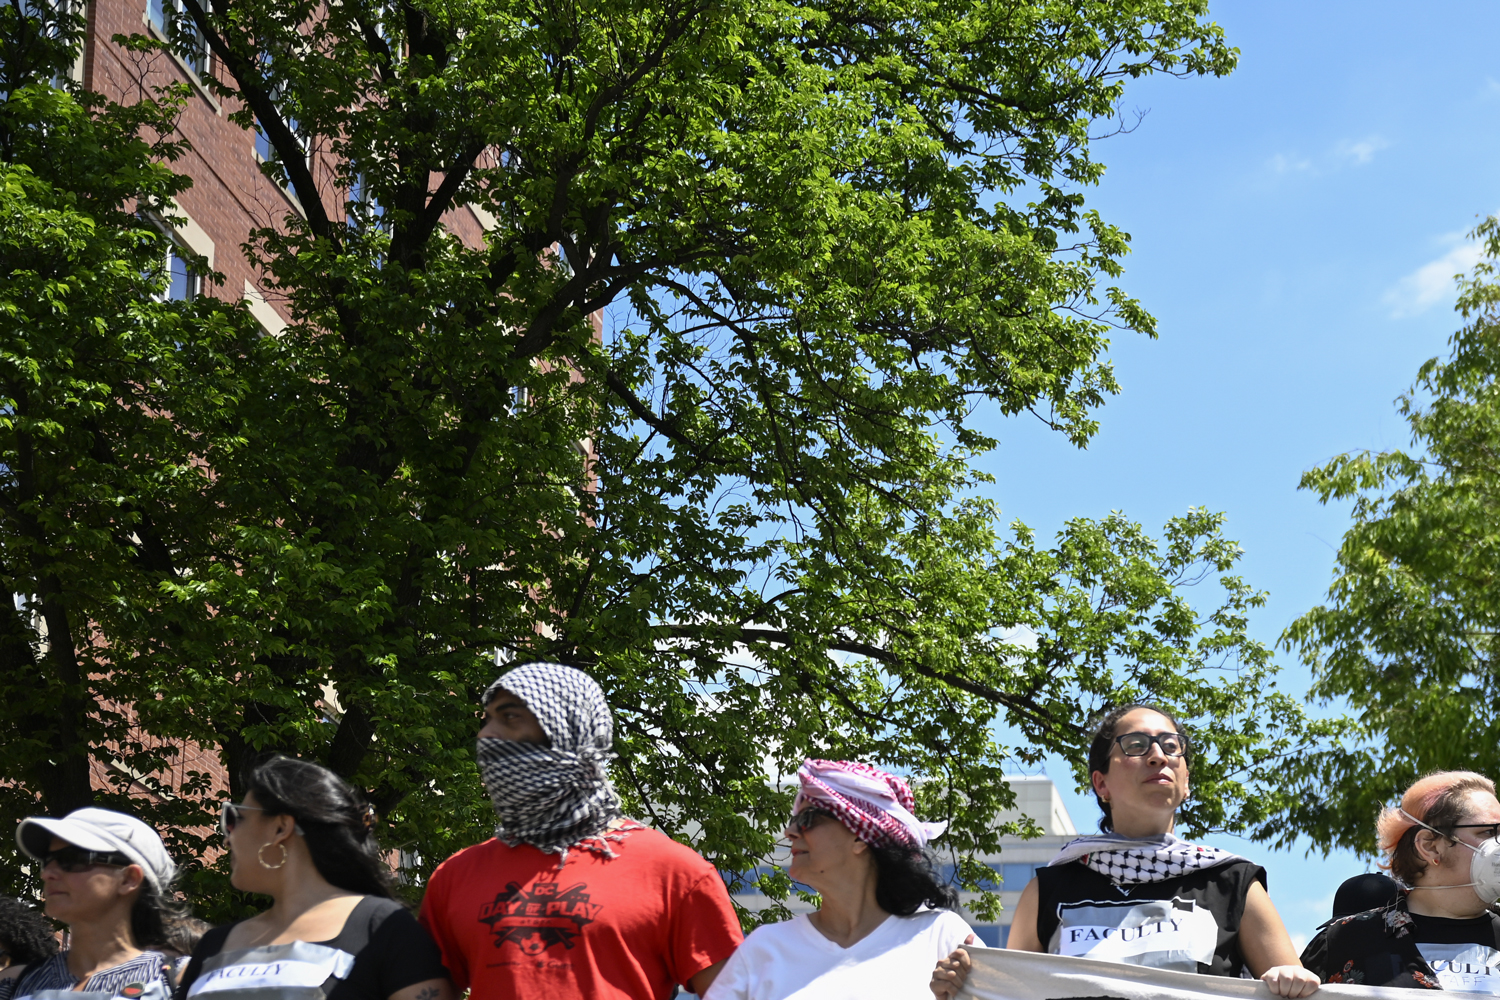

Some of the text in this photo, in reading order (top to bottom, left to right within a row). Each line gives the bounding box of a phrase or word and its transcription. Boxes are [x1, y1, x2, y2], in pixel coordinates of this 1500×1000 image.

[533, 886, 555, 896] DC
[480, 901, 523, 919] DAY
[545, 900, 602, 921] PLAY
[1069, 917, 1183, 944] FACULTY
[206, 963, 289, 983] FACULTY
[1442, 973, 1486, 987] TAFF
